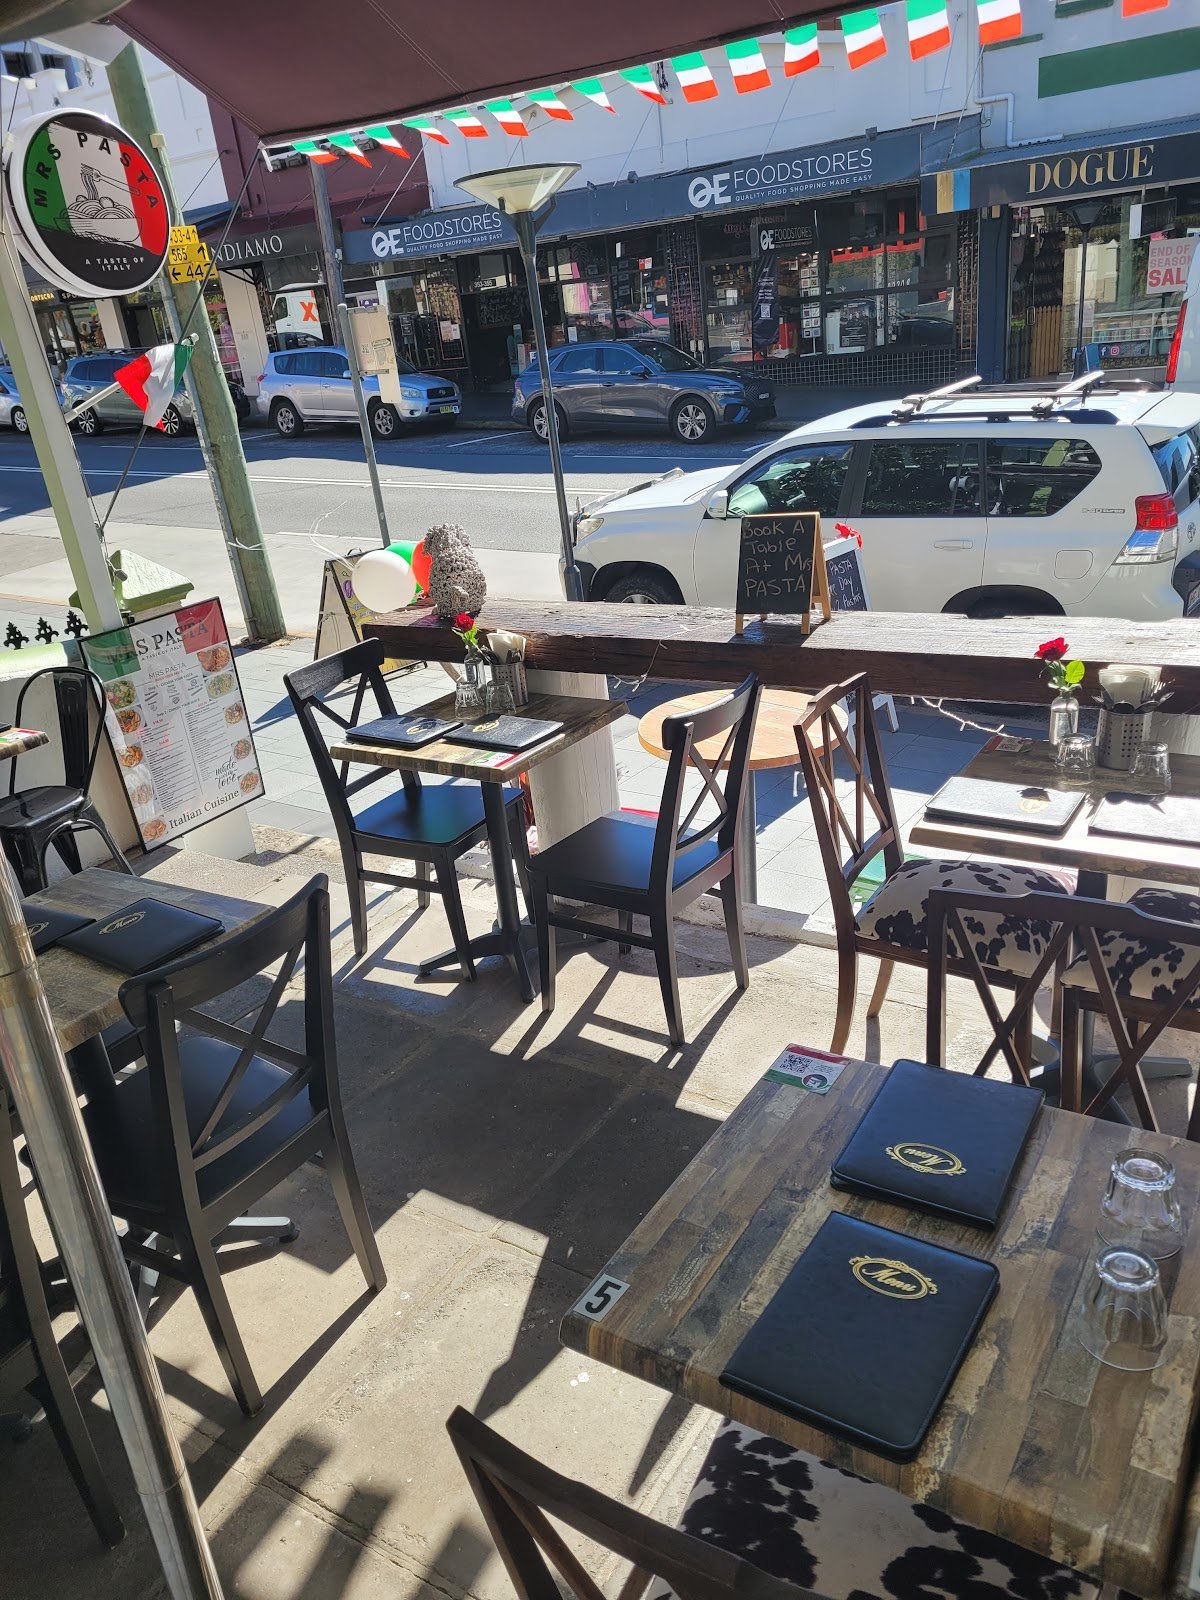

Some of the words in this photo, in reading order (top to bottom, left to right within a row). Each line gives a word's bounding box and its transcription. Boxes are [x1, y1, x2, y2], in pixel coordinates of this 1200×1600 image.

[34, 143, 62, 208] MRS
[77, 132, 158, 208] PASTA
[733, 148, 873, 189] FOODSTORES
[1026, 144, 1155, 194] DOGUE
[735, 191, 765, 202] QUALITY
[767, 188, 787, 197] FOOD
[789, 181, 827, 193] SHOPPING
[829, 177, 850, 187] MADE
[853, 173, 873, 183] EASY
[403, 211, 502, 242] FOODSTORES
[406, 244, 428, 253] QUALITY
[445, 238, 471, 248] SHOPPING
[472, 235, 488, 243] MADE
[488, 233, 503, 242] EASY
[1151, 246, 1173, 258] END
[1176, 243, 1191, 255] OF
[96, 256, 128, 265] TASTE
[133, 256, 145, 264] OF
[171, 247, 188, 262] 565
[102, 264, 131, 272] ITALY
[792, 519, 805, 534] A
[744, 538, 797, 555] Table
[745, 557, 772, 575] At
[828, 559, 853, 576] PASTA
[744, 573, 806, 598] PASTA
[148, 669, 164, 680] MRS
[165, 662, 187, 674] PASTA
[169, 808, 203, 829] Italian
[203, 789, 240, 812] Cuisine
[861, 1268, 917, 1292] Menu
[585, 1280, 622, 1314] 5
